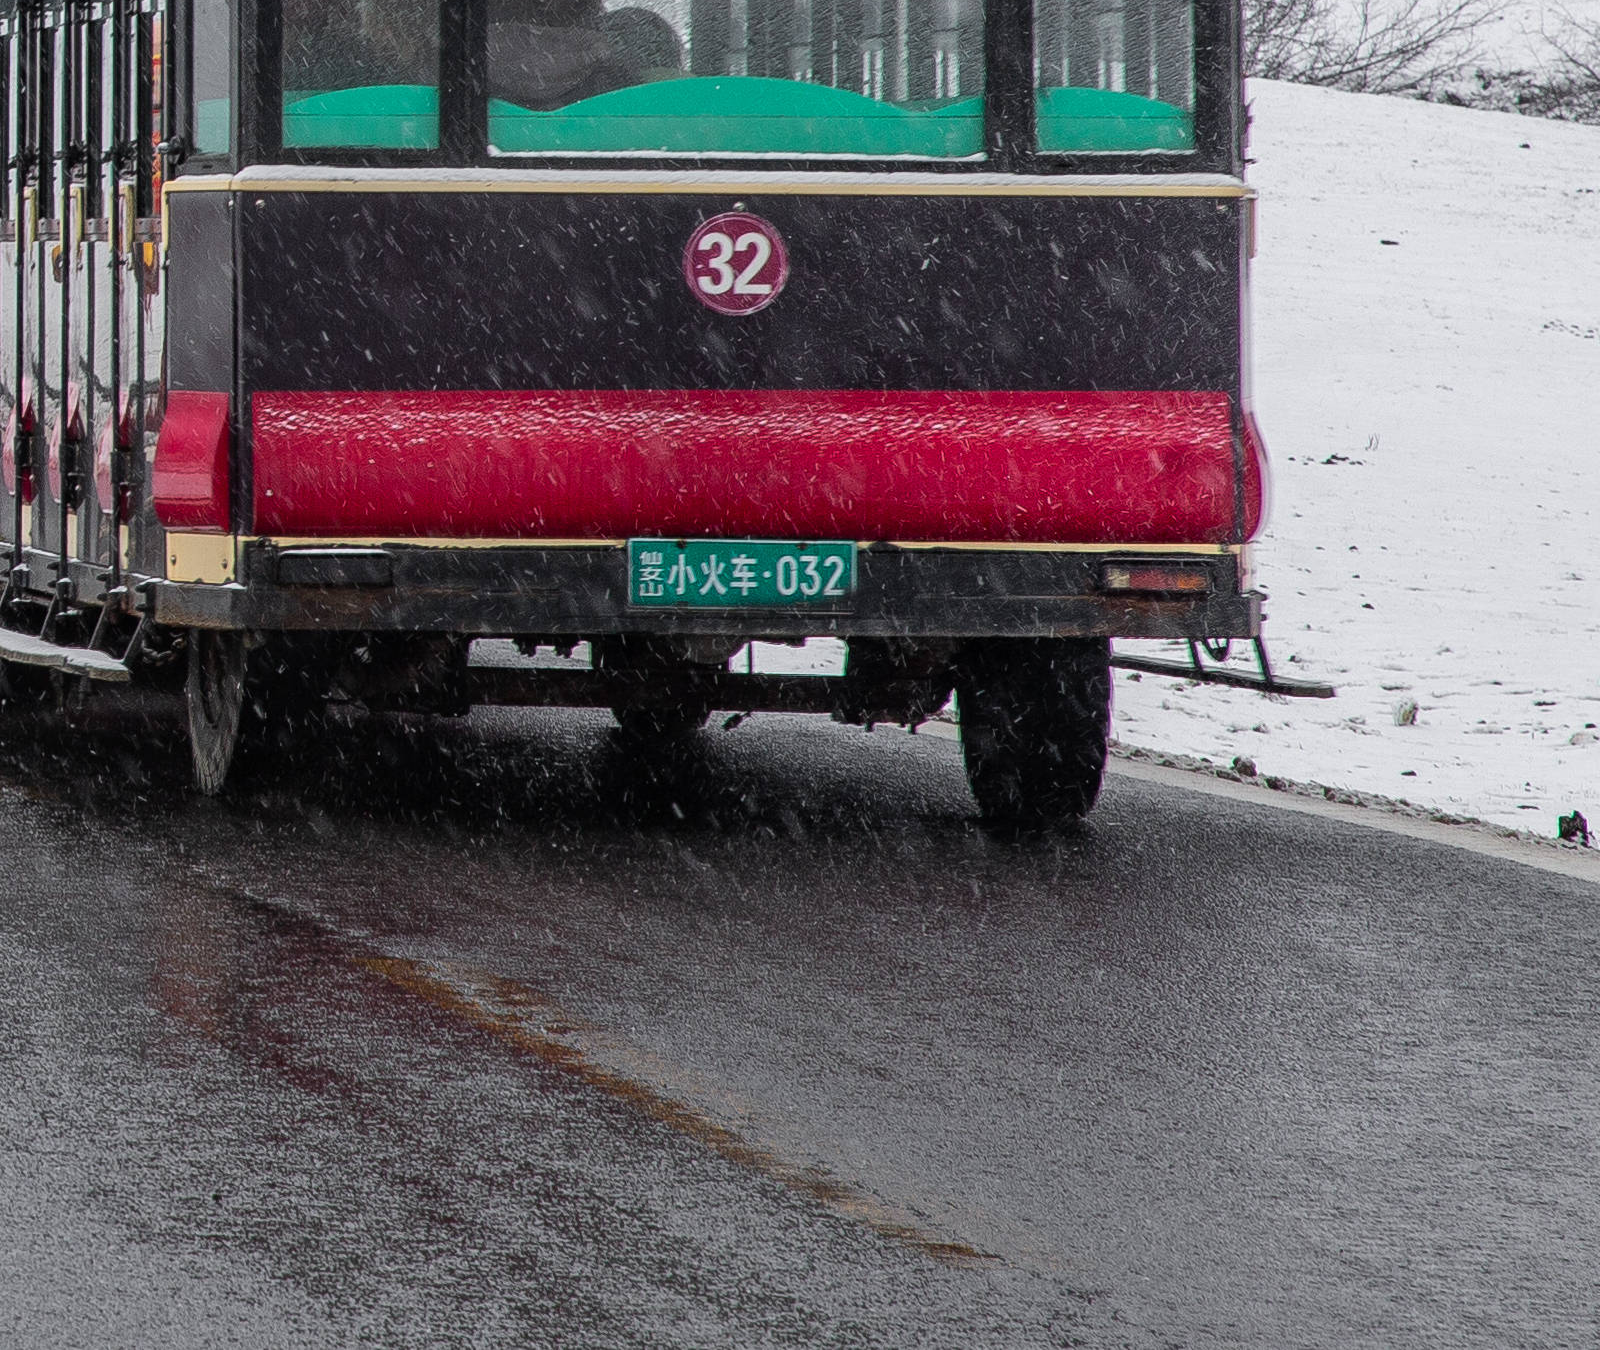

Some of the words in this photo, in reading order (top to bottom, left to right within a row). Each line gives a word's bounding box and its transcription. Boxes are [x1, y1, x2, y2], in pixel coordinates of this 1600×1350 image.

[697, 232, 773, 295] 32
[639, 551, 664, 597] 仙女山
